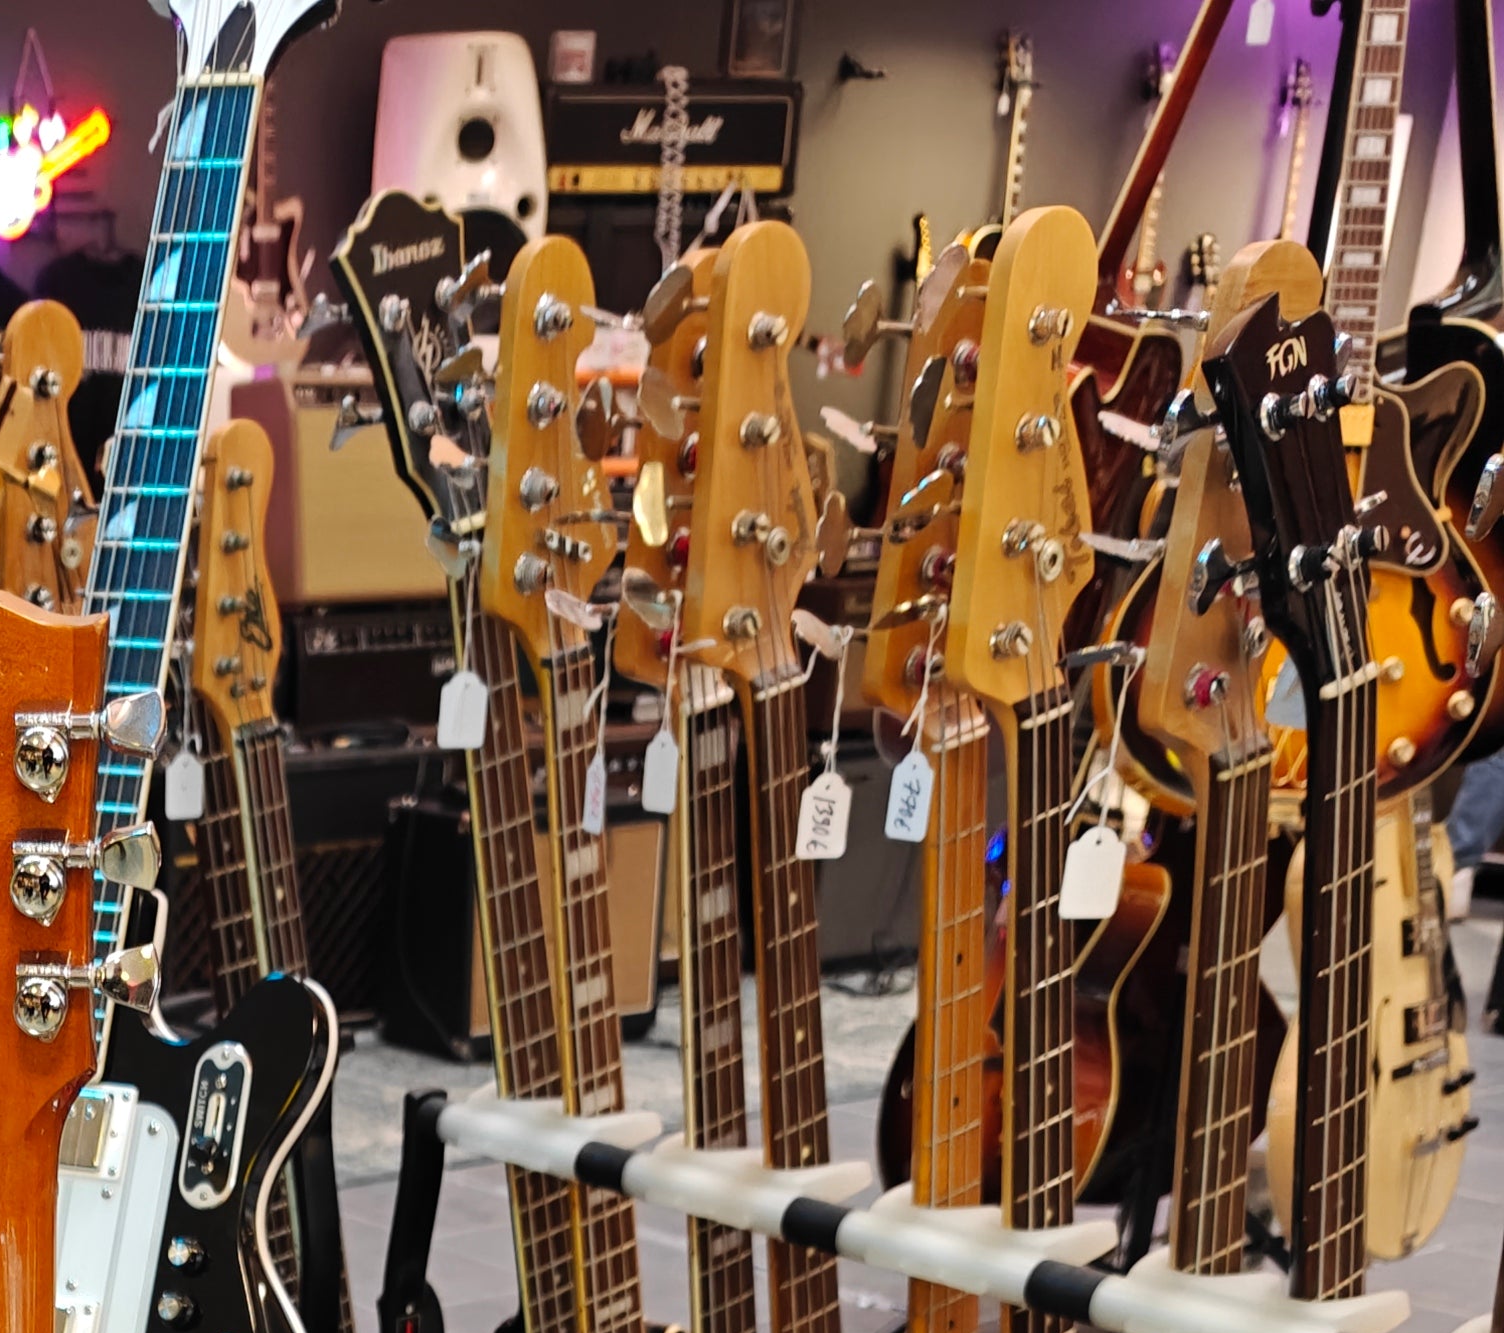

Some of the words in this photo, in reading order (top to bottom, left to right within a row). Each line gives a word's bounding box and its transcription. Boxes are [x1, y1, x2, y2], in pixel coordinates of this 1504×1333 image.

[370, 235, 445, 277] Ibanez
[1265, 335, 1307, 382] FGN
[194, 1080, 209, 1129] SWITCH
